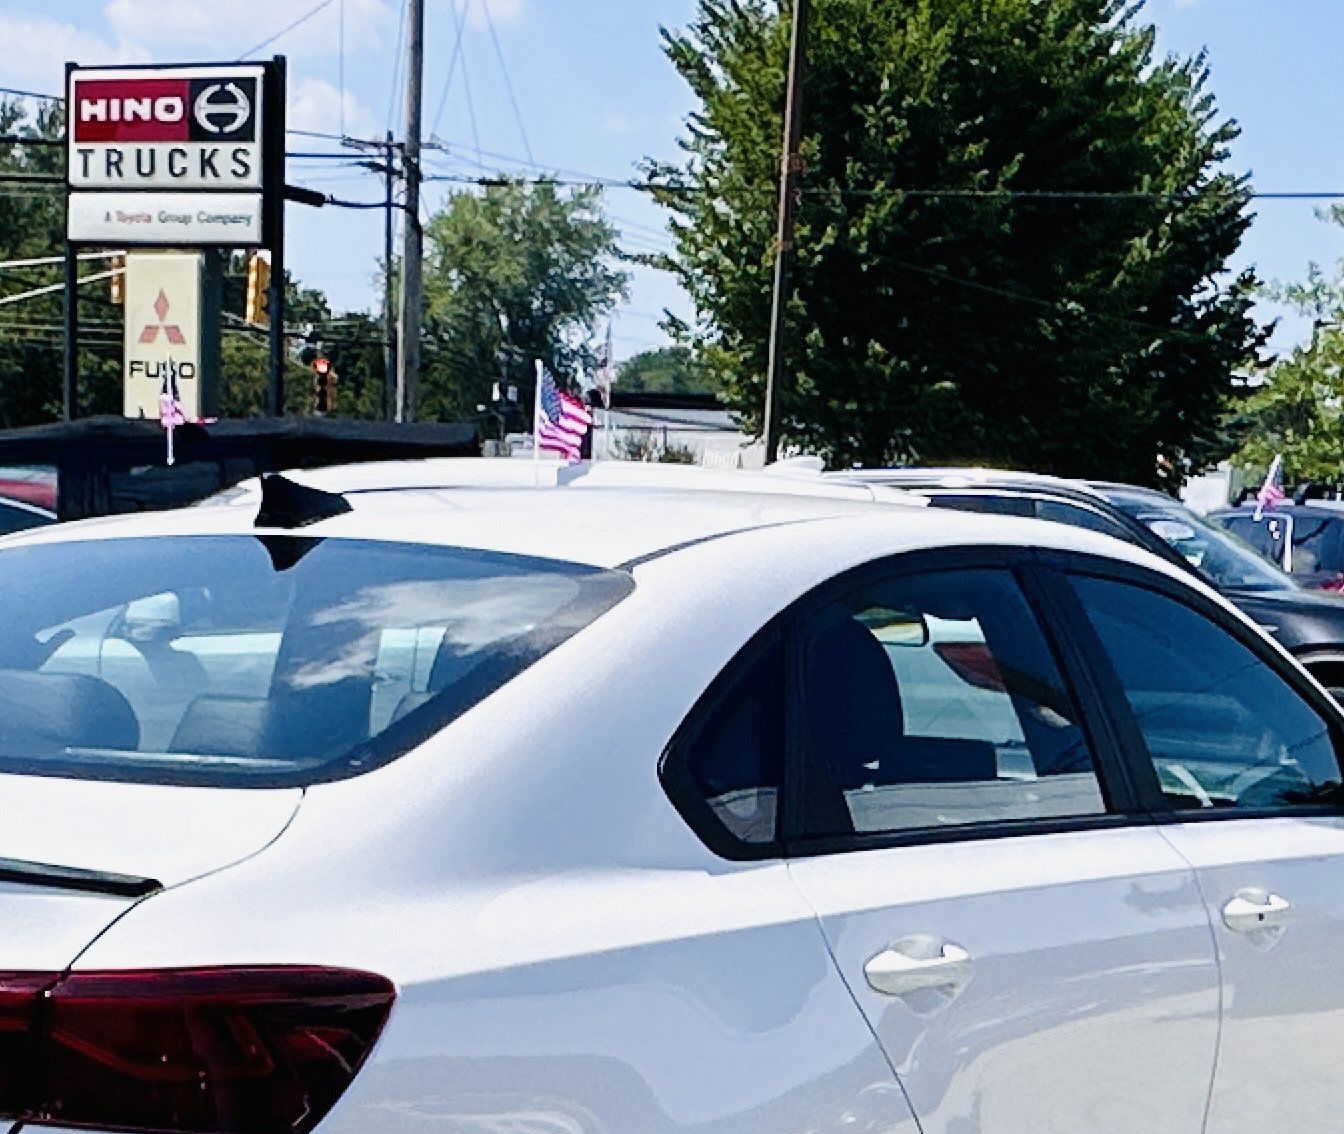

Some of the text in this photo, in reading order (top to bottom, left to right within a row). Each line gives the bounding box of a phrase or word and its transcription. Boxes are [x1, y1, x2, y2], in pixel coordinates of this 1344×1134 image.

[80, 96, 184, 122] HINO
[76, 147, 251, 178] TRUCKS
[197, 210, 253, 226] Company
